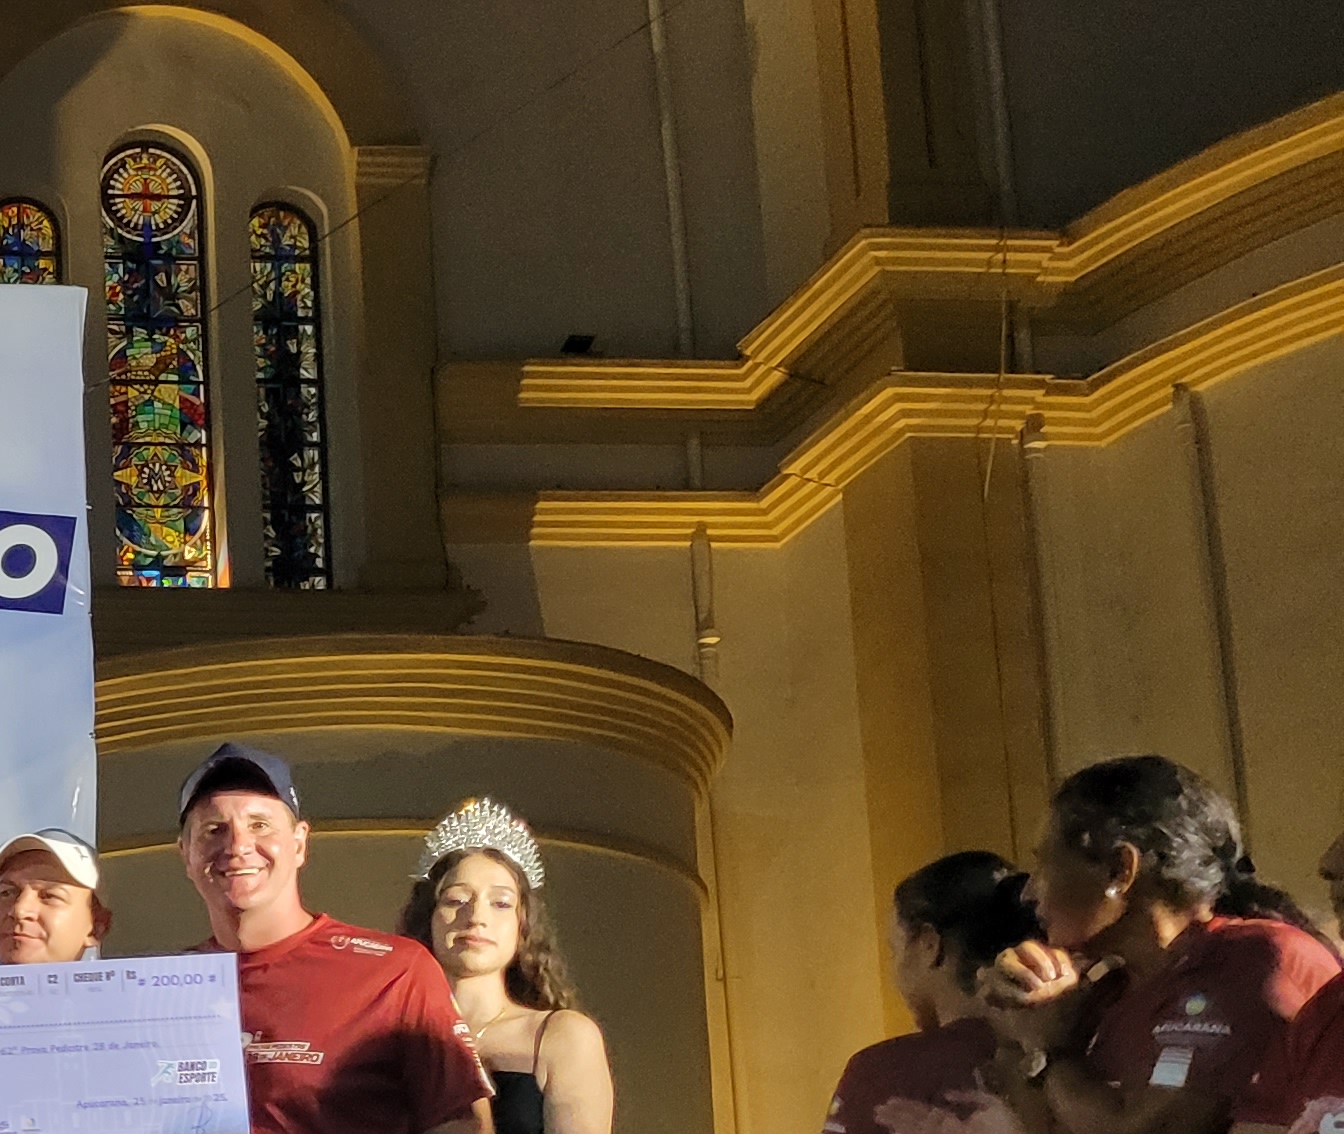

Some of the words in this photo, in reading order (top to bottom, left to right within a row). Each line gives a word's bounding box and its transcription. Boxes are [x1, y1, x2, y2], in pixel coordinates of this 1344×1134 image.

[0, 975, 26, 986] CONTA
[47, 974, 59, 984] C2
[73, 971, 103, 982] CHEQUE
[151, 973, 203, 987] 200,00
[177, 1060, 207, 1072] BANCO
[178, 1071, 217, 1084] ESPORTE
